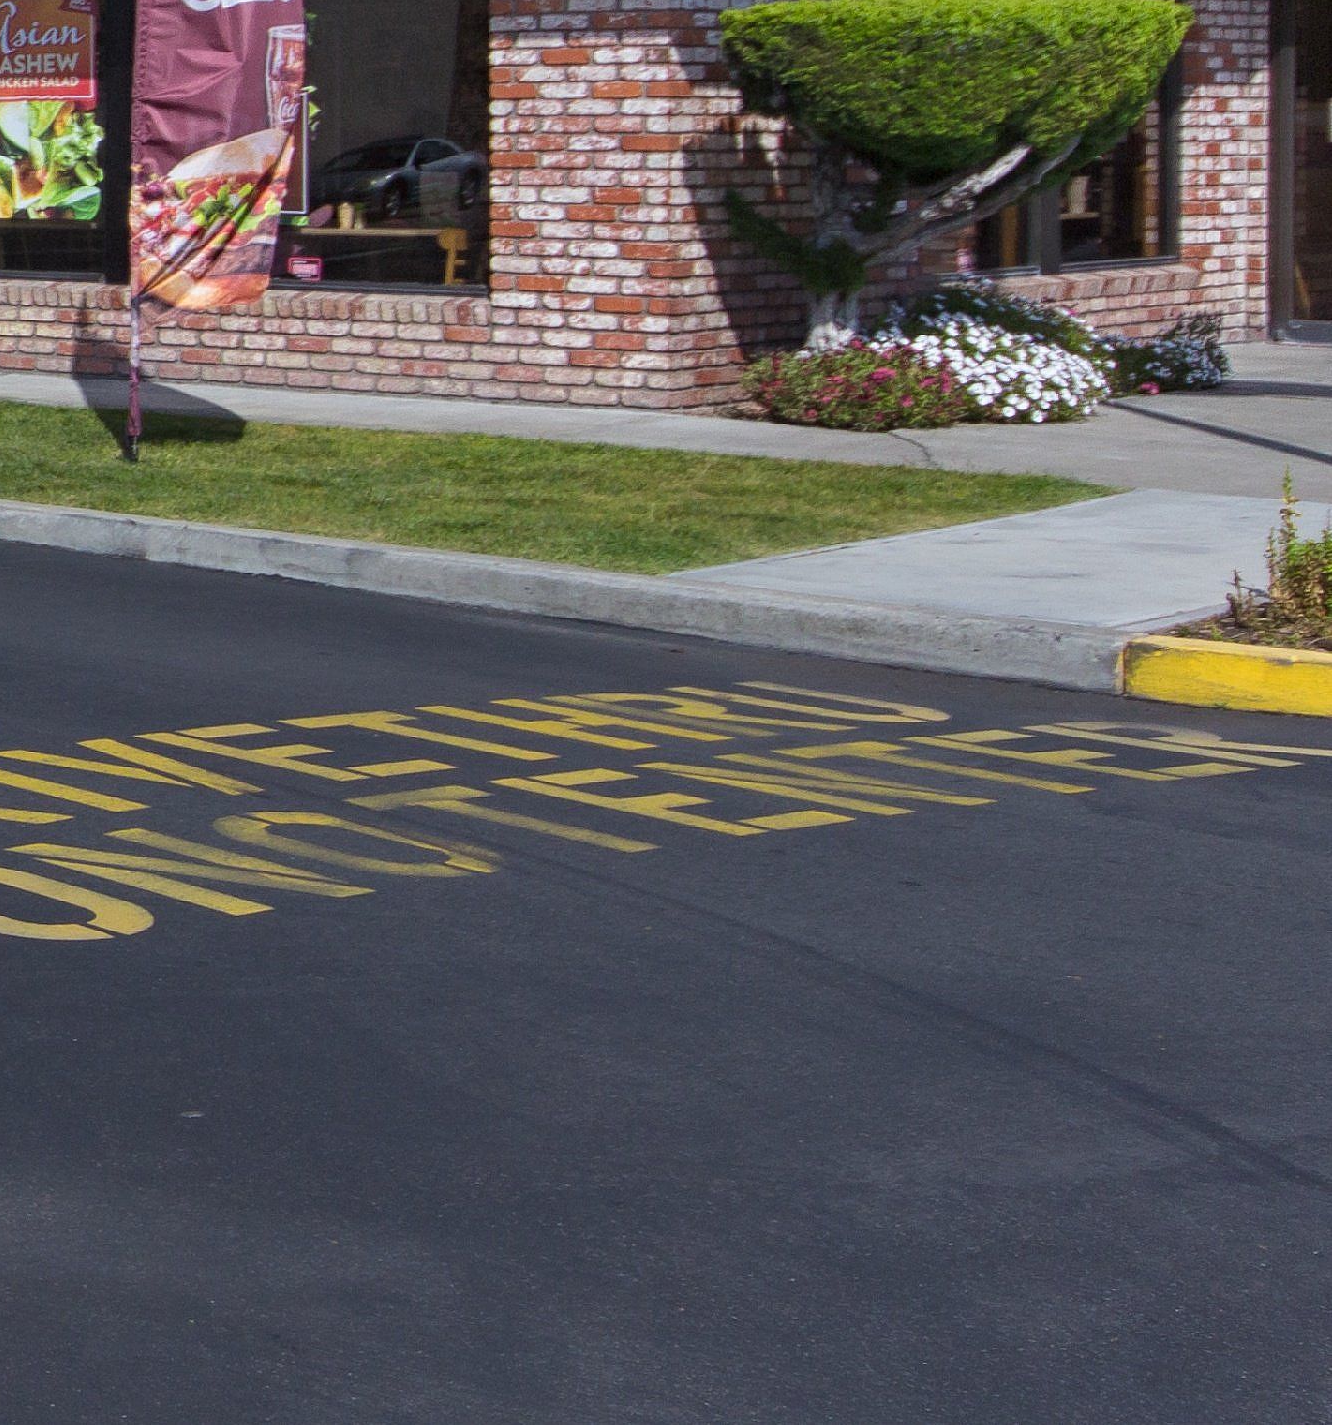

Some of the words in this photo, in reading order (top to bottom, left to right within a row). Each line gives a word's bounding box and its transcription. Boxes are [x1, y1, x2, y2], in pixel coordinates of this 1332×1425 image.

[40, 76, 80, 87] SALAD
[4, 783, 660, 917] NOT
[490, 720, 1332, 836] ENTER
